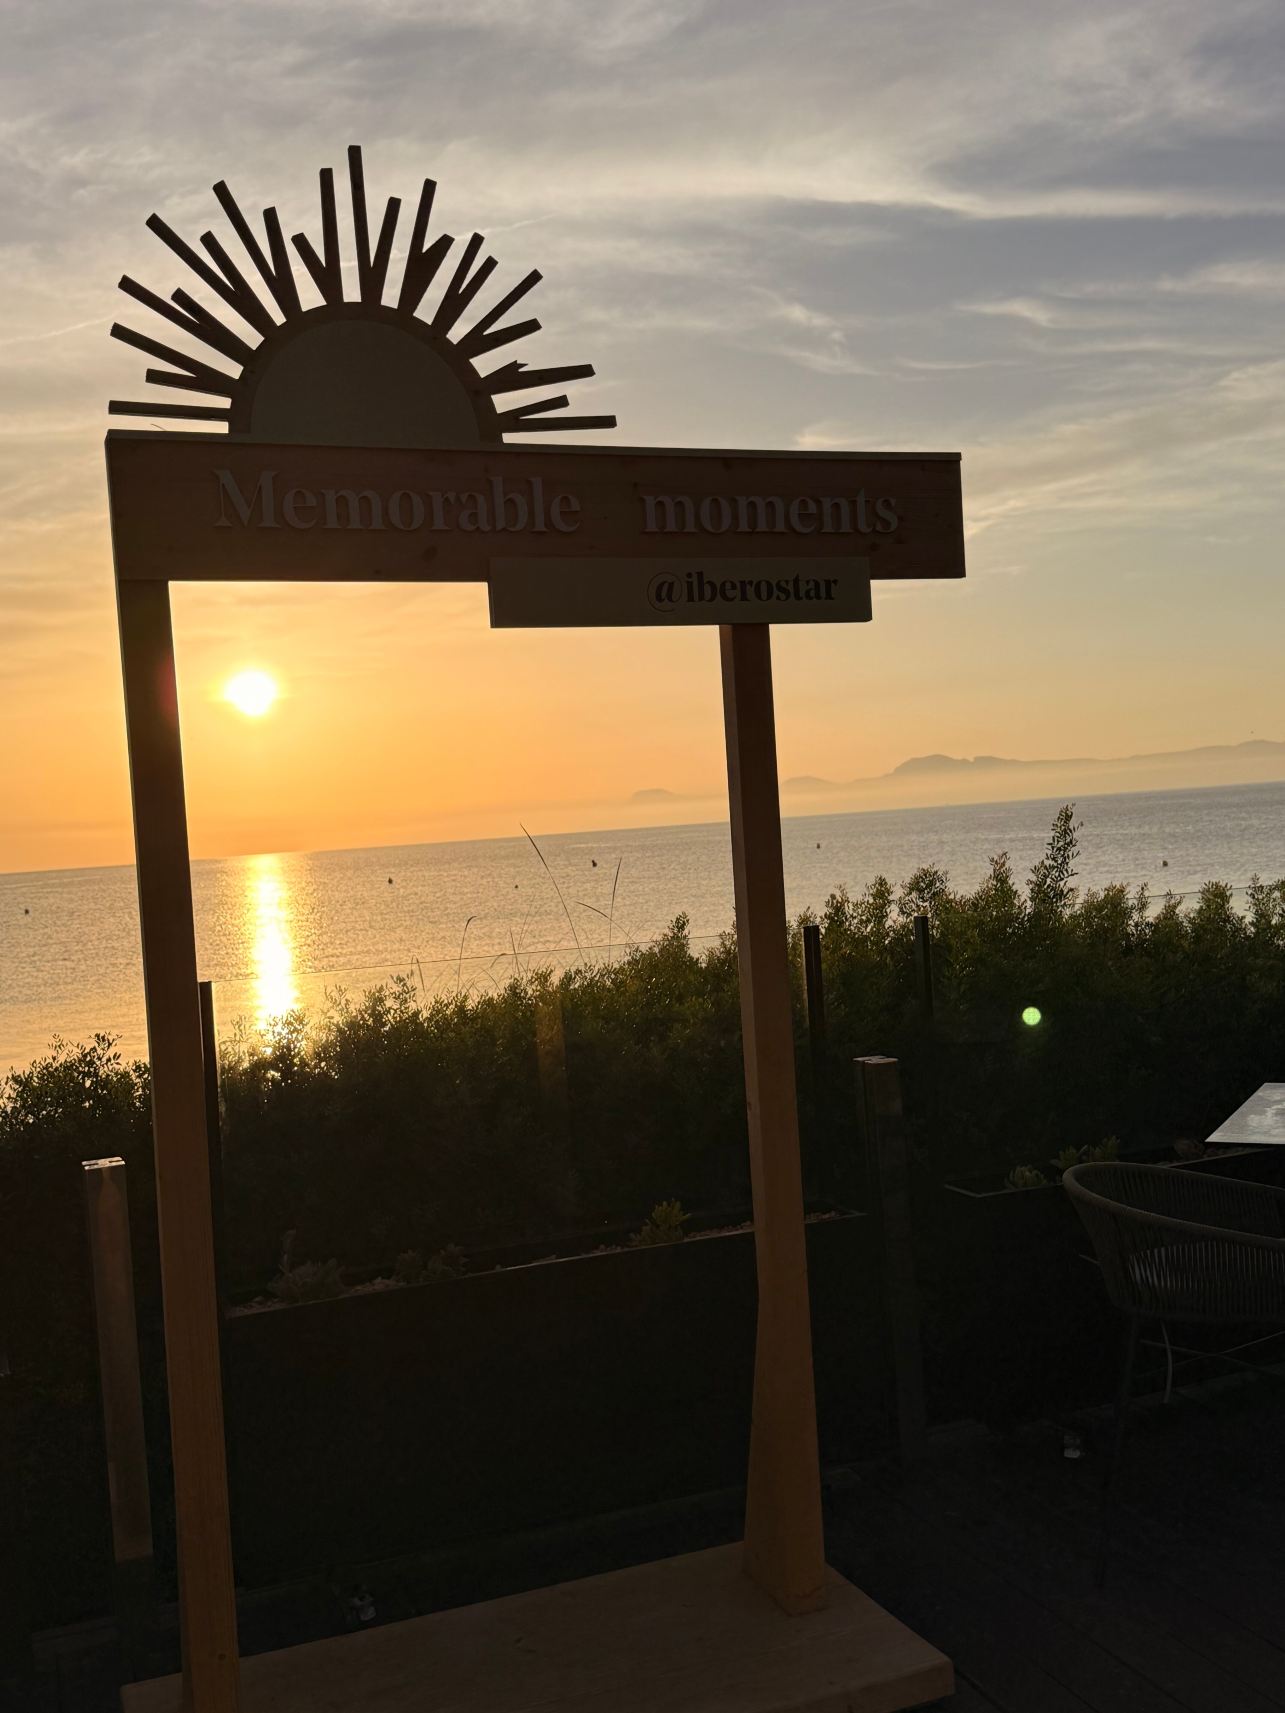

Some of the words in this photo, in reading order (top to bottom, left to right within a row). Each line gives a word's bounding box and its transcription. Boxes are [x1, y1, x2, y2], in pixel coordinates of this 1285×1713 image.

[213, 469, 582, 534] Memorable
[641, 488, 899, 536] moments
[647, 571, 839, 612] @iberostar
